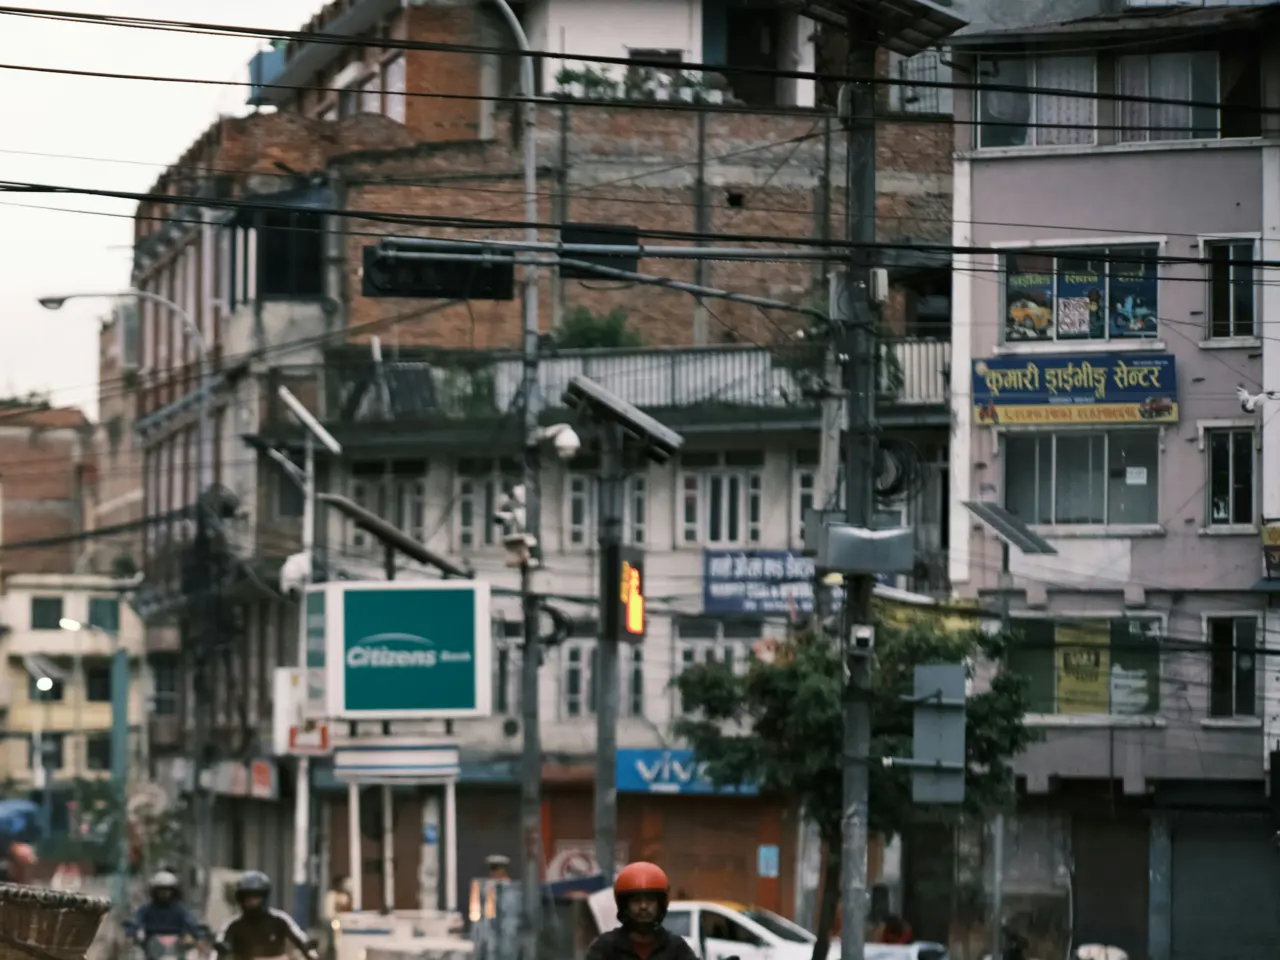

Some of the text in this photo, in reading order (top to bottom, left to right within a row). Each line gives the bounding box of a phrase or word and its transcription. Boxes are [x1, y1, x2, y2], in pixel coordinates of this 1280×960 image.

[985, 361, 1039, 396] कुमारी
[1114, 360, 1162, 389] सेन्टर
[347, 646, 437, 668] Citizens
